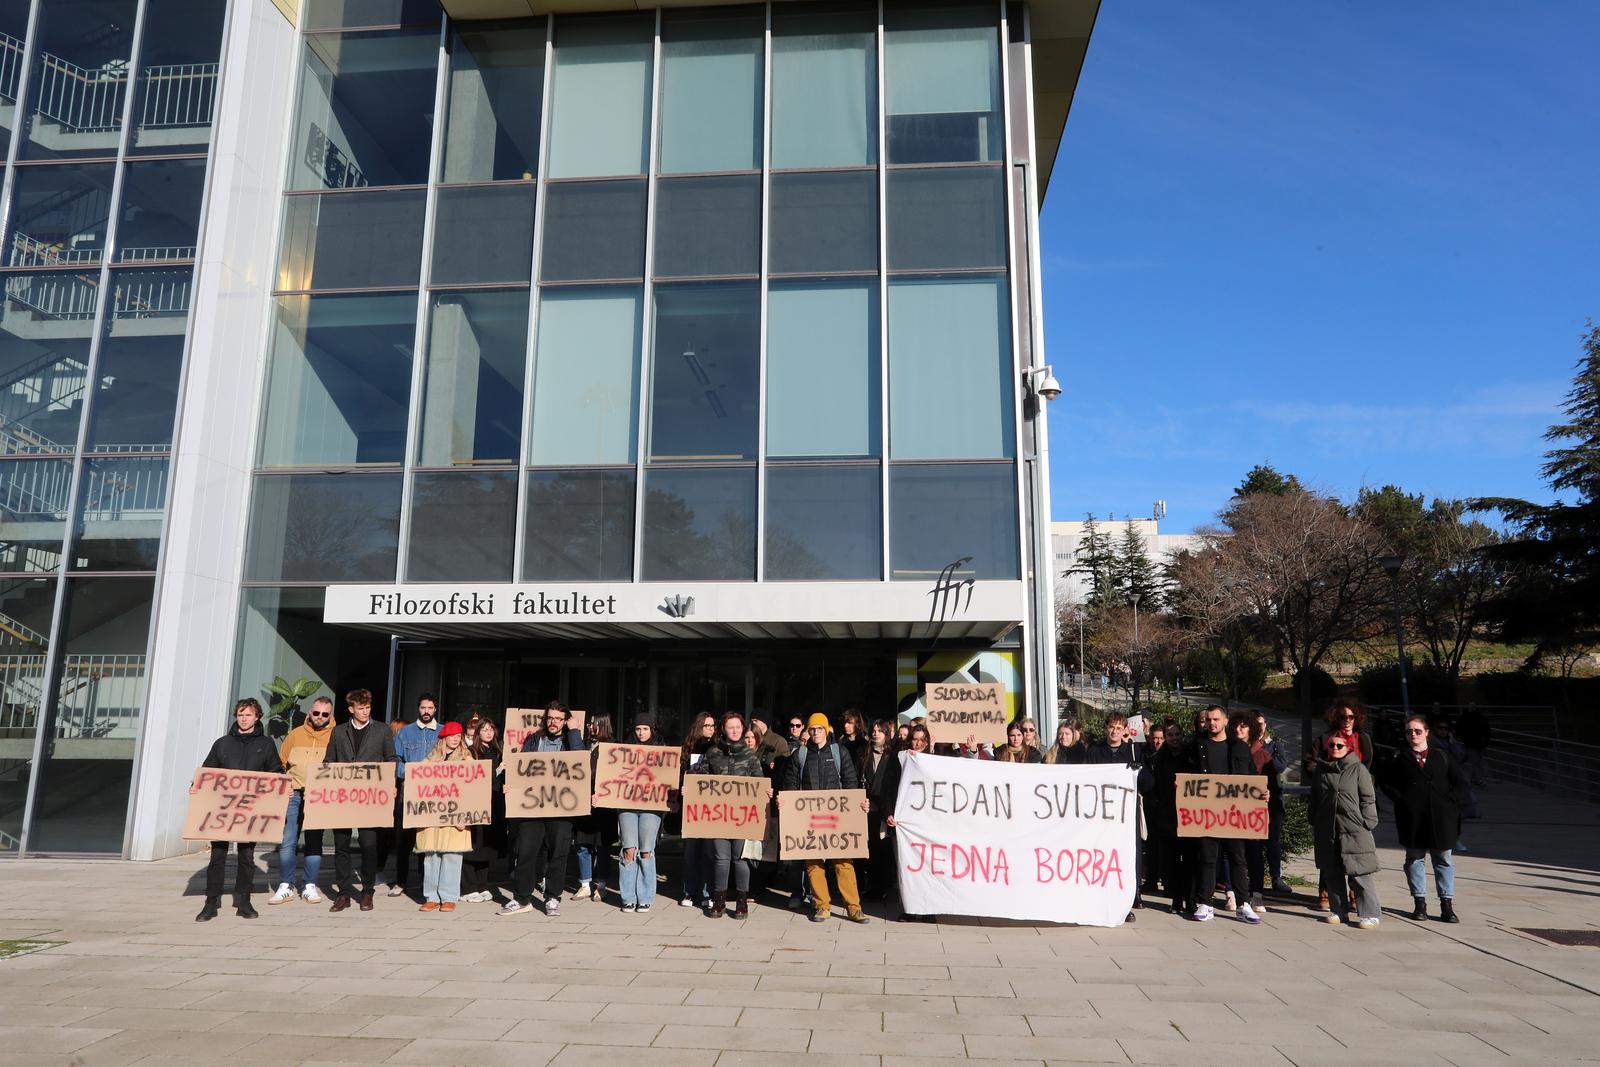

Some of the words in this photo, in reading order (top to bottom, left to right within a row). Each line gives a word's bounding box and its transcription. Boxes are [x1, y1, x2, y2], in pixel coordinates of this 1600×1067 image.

[368, 593, 495, 616] Filozofski
[512, 592, 617, 615] fakultet
[933, 686, 998, 705] SLOBODA
[928, 710, 1006, 725] STUDENTIMA
[607, 746, 679, 769] STUDENTI
[410, 764, 486, 784] KORUPCIJA
[517, 758, 547, 777] UZ
[550, 758, 586, 780] VAS
[618, 765, 656, 783] ZA
[195, 772, 293, 796] PROTEST
[417, 783, 460, 798] VLADA
[696, 779, 760, 798] PROTIV
[1183, 778, 1210, 798] NE
[1215, 781, 1265, 801] DAMO
[219, 794, 257, 811] JE
[309, 787, 389, 806] SLOBODNO
[521, 785, 578, 812] SMO
[795, 796, 850, 813] OTPOR
[910, 780, 1013, 820] JEDAN
[1033, 782, 1135, 824] SVIJET
[406, 800, 459, 816] NAROD
[439, 810, 491, 825] STRADA
[686, 803, 760, 827] NASILJA
[198, 811, 280, 834] ISPIT
[785, 829, 862, 852] DUŽNOST
[906, 842, 1010, 886] JEDNA
[1033, 846, 1124, 890] BORBA
